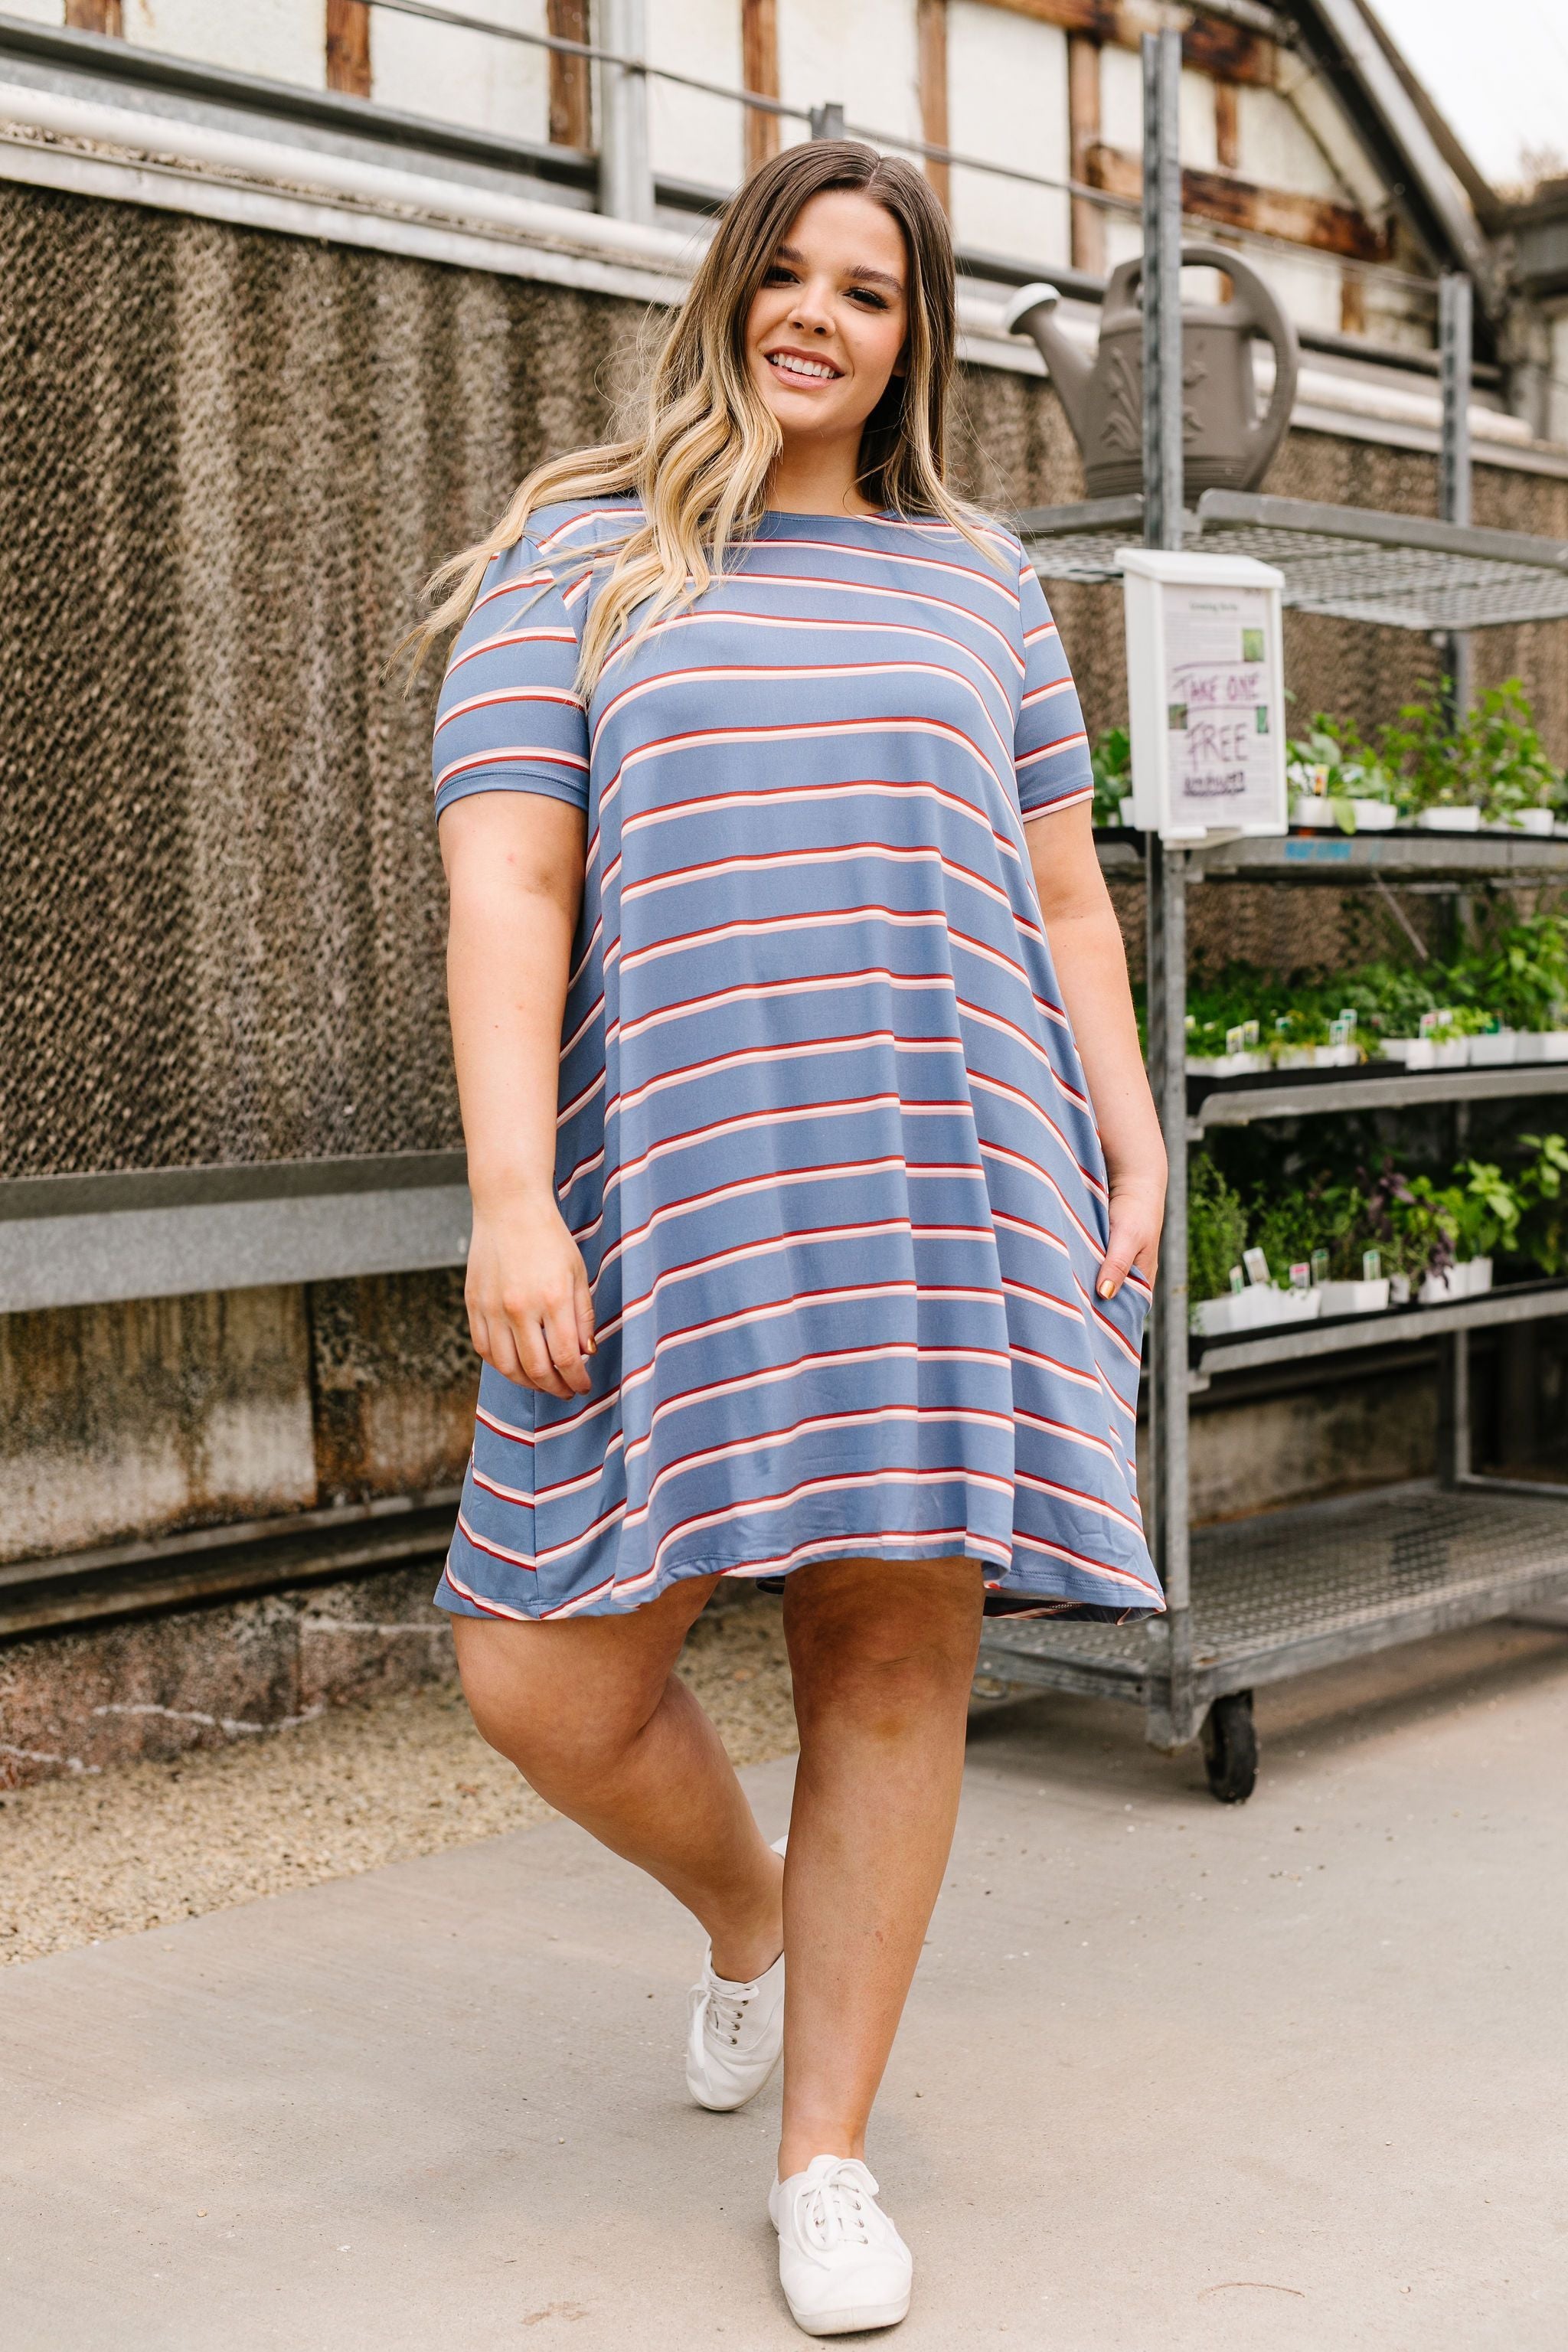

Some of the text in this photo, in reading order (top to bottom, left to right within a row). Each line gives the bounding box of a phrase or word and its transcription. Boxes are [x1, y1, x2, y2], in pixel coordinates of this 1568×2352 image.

[1172, 671, 1259, 702] TAKE ONE
[1184, 721, 1248, 772] FREE
